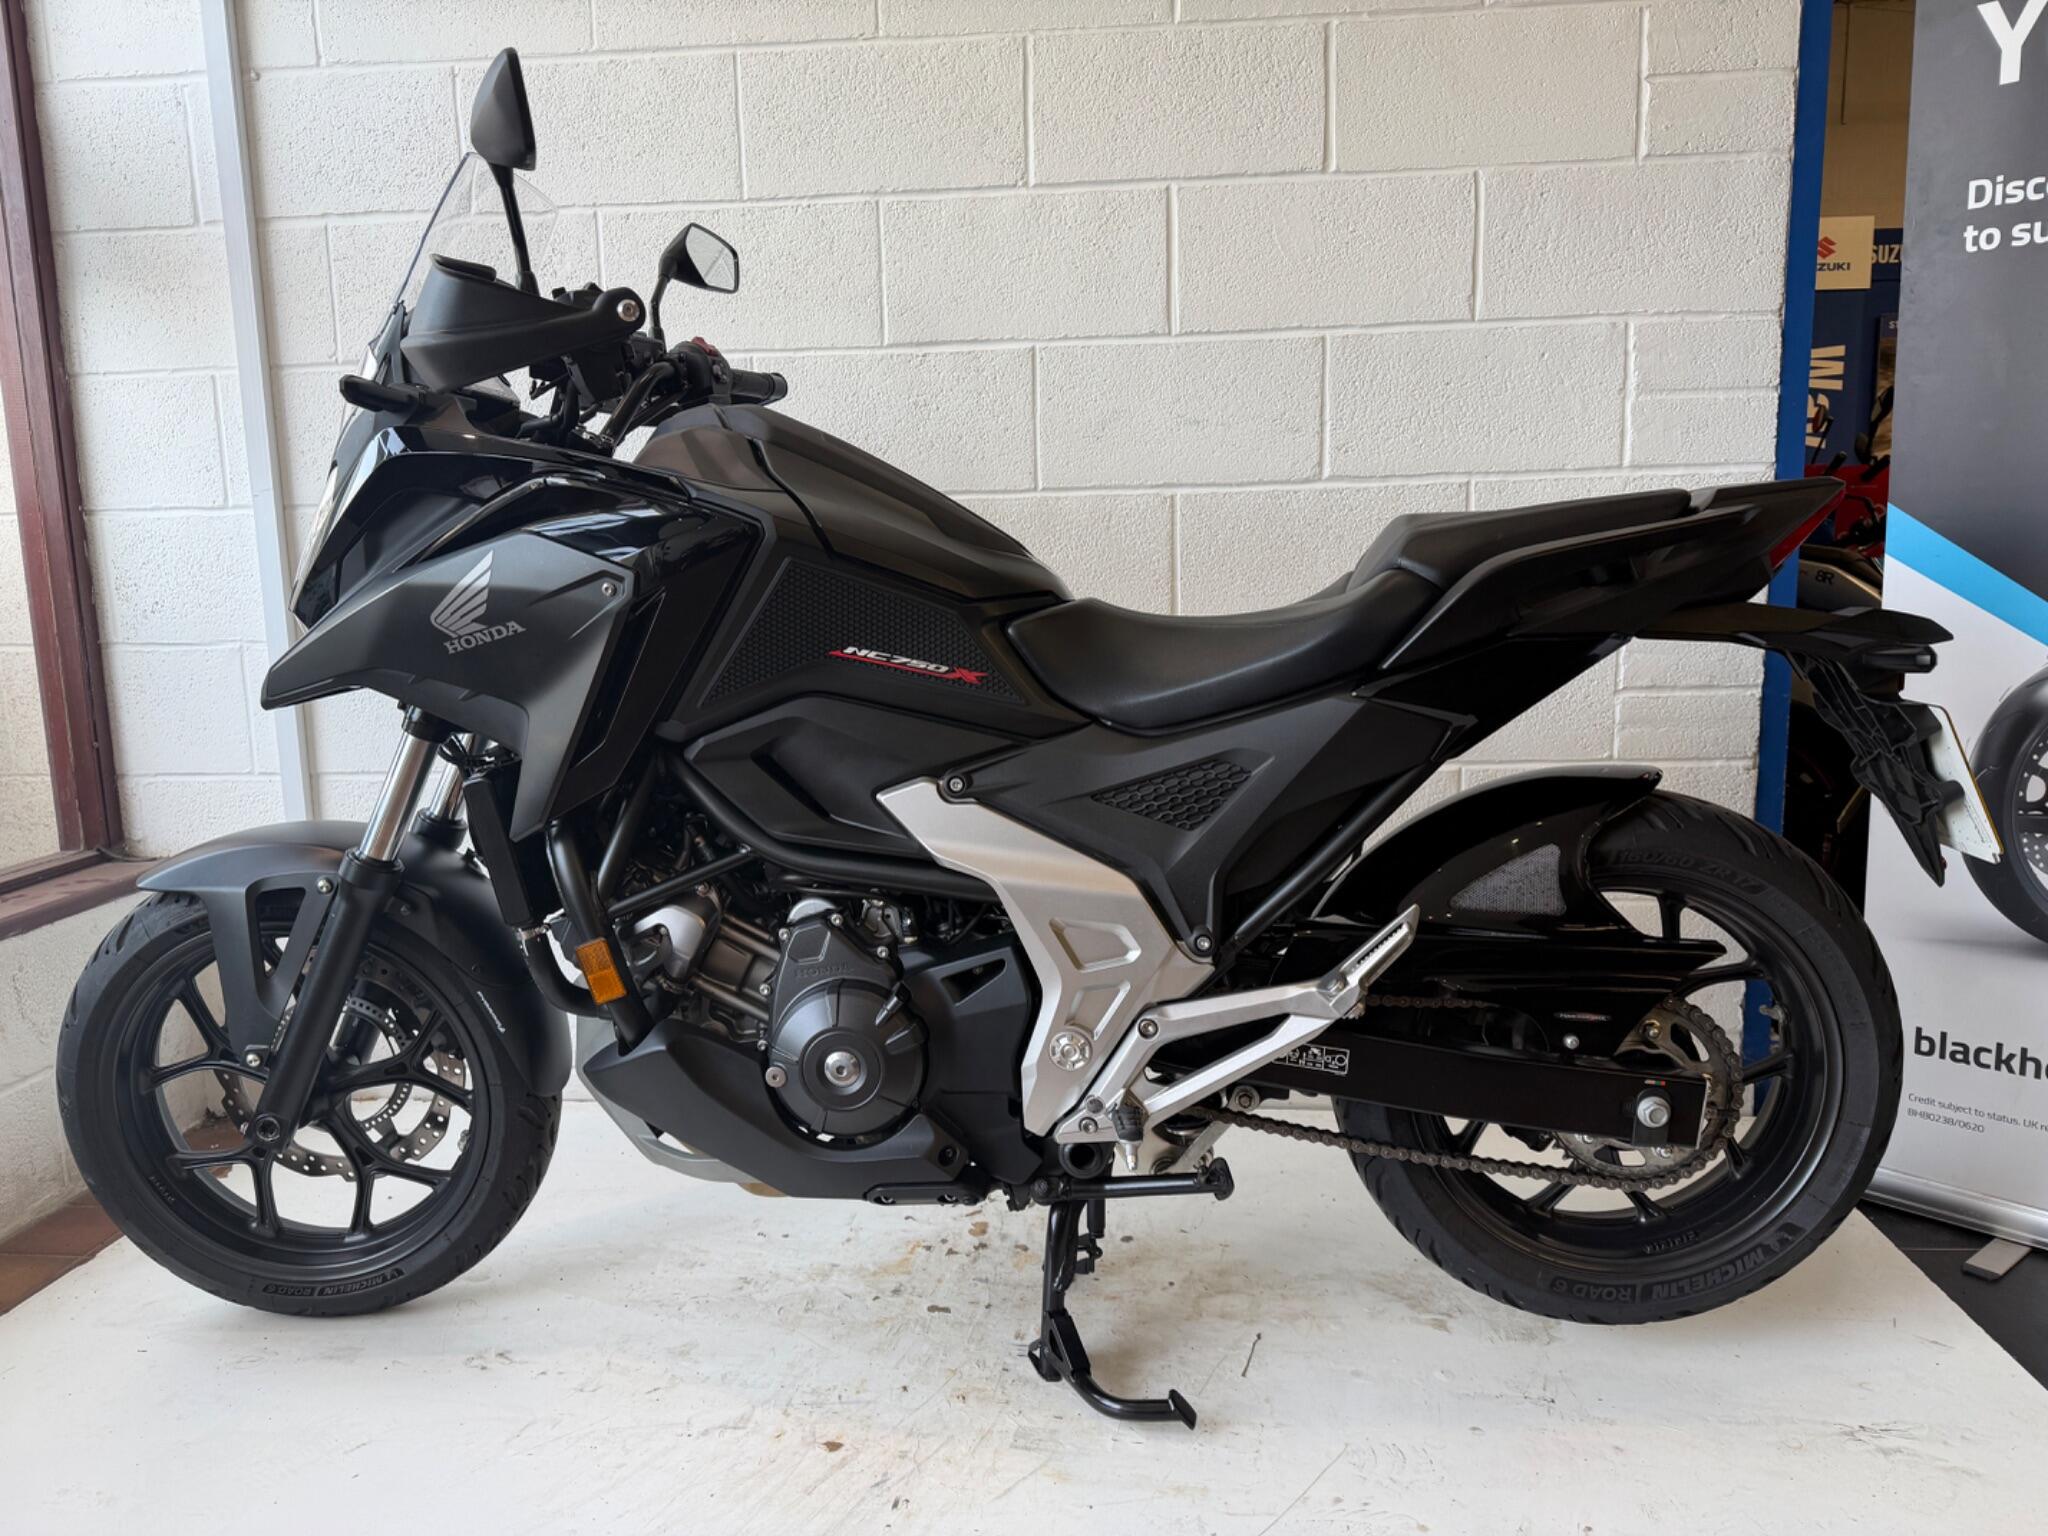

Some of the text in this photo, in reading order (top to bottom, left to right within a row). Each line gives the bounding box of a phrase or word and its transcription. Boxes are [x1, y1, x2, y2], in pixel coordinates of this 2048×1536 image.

[1967, 174, 2048, 210] Disc
[1963, 225, 2001, 253] to
[443, 620, 527, 655] HONDA
[1914, 1026, 2048, 1080] blackh
[1908, 1092, 1936, 1107] Credit
[1938, 1101, 1972, 1115] subject
[1974, 1108, 1985, 1118] to
[2022, 1118, 2039, 1130] UK
[323, 1275, 384, 1296] MICHELIN
[1652, 1243, 1766, 1299] MICHELIN
[1572, 1285, 1636, 1301] ROAD
